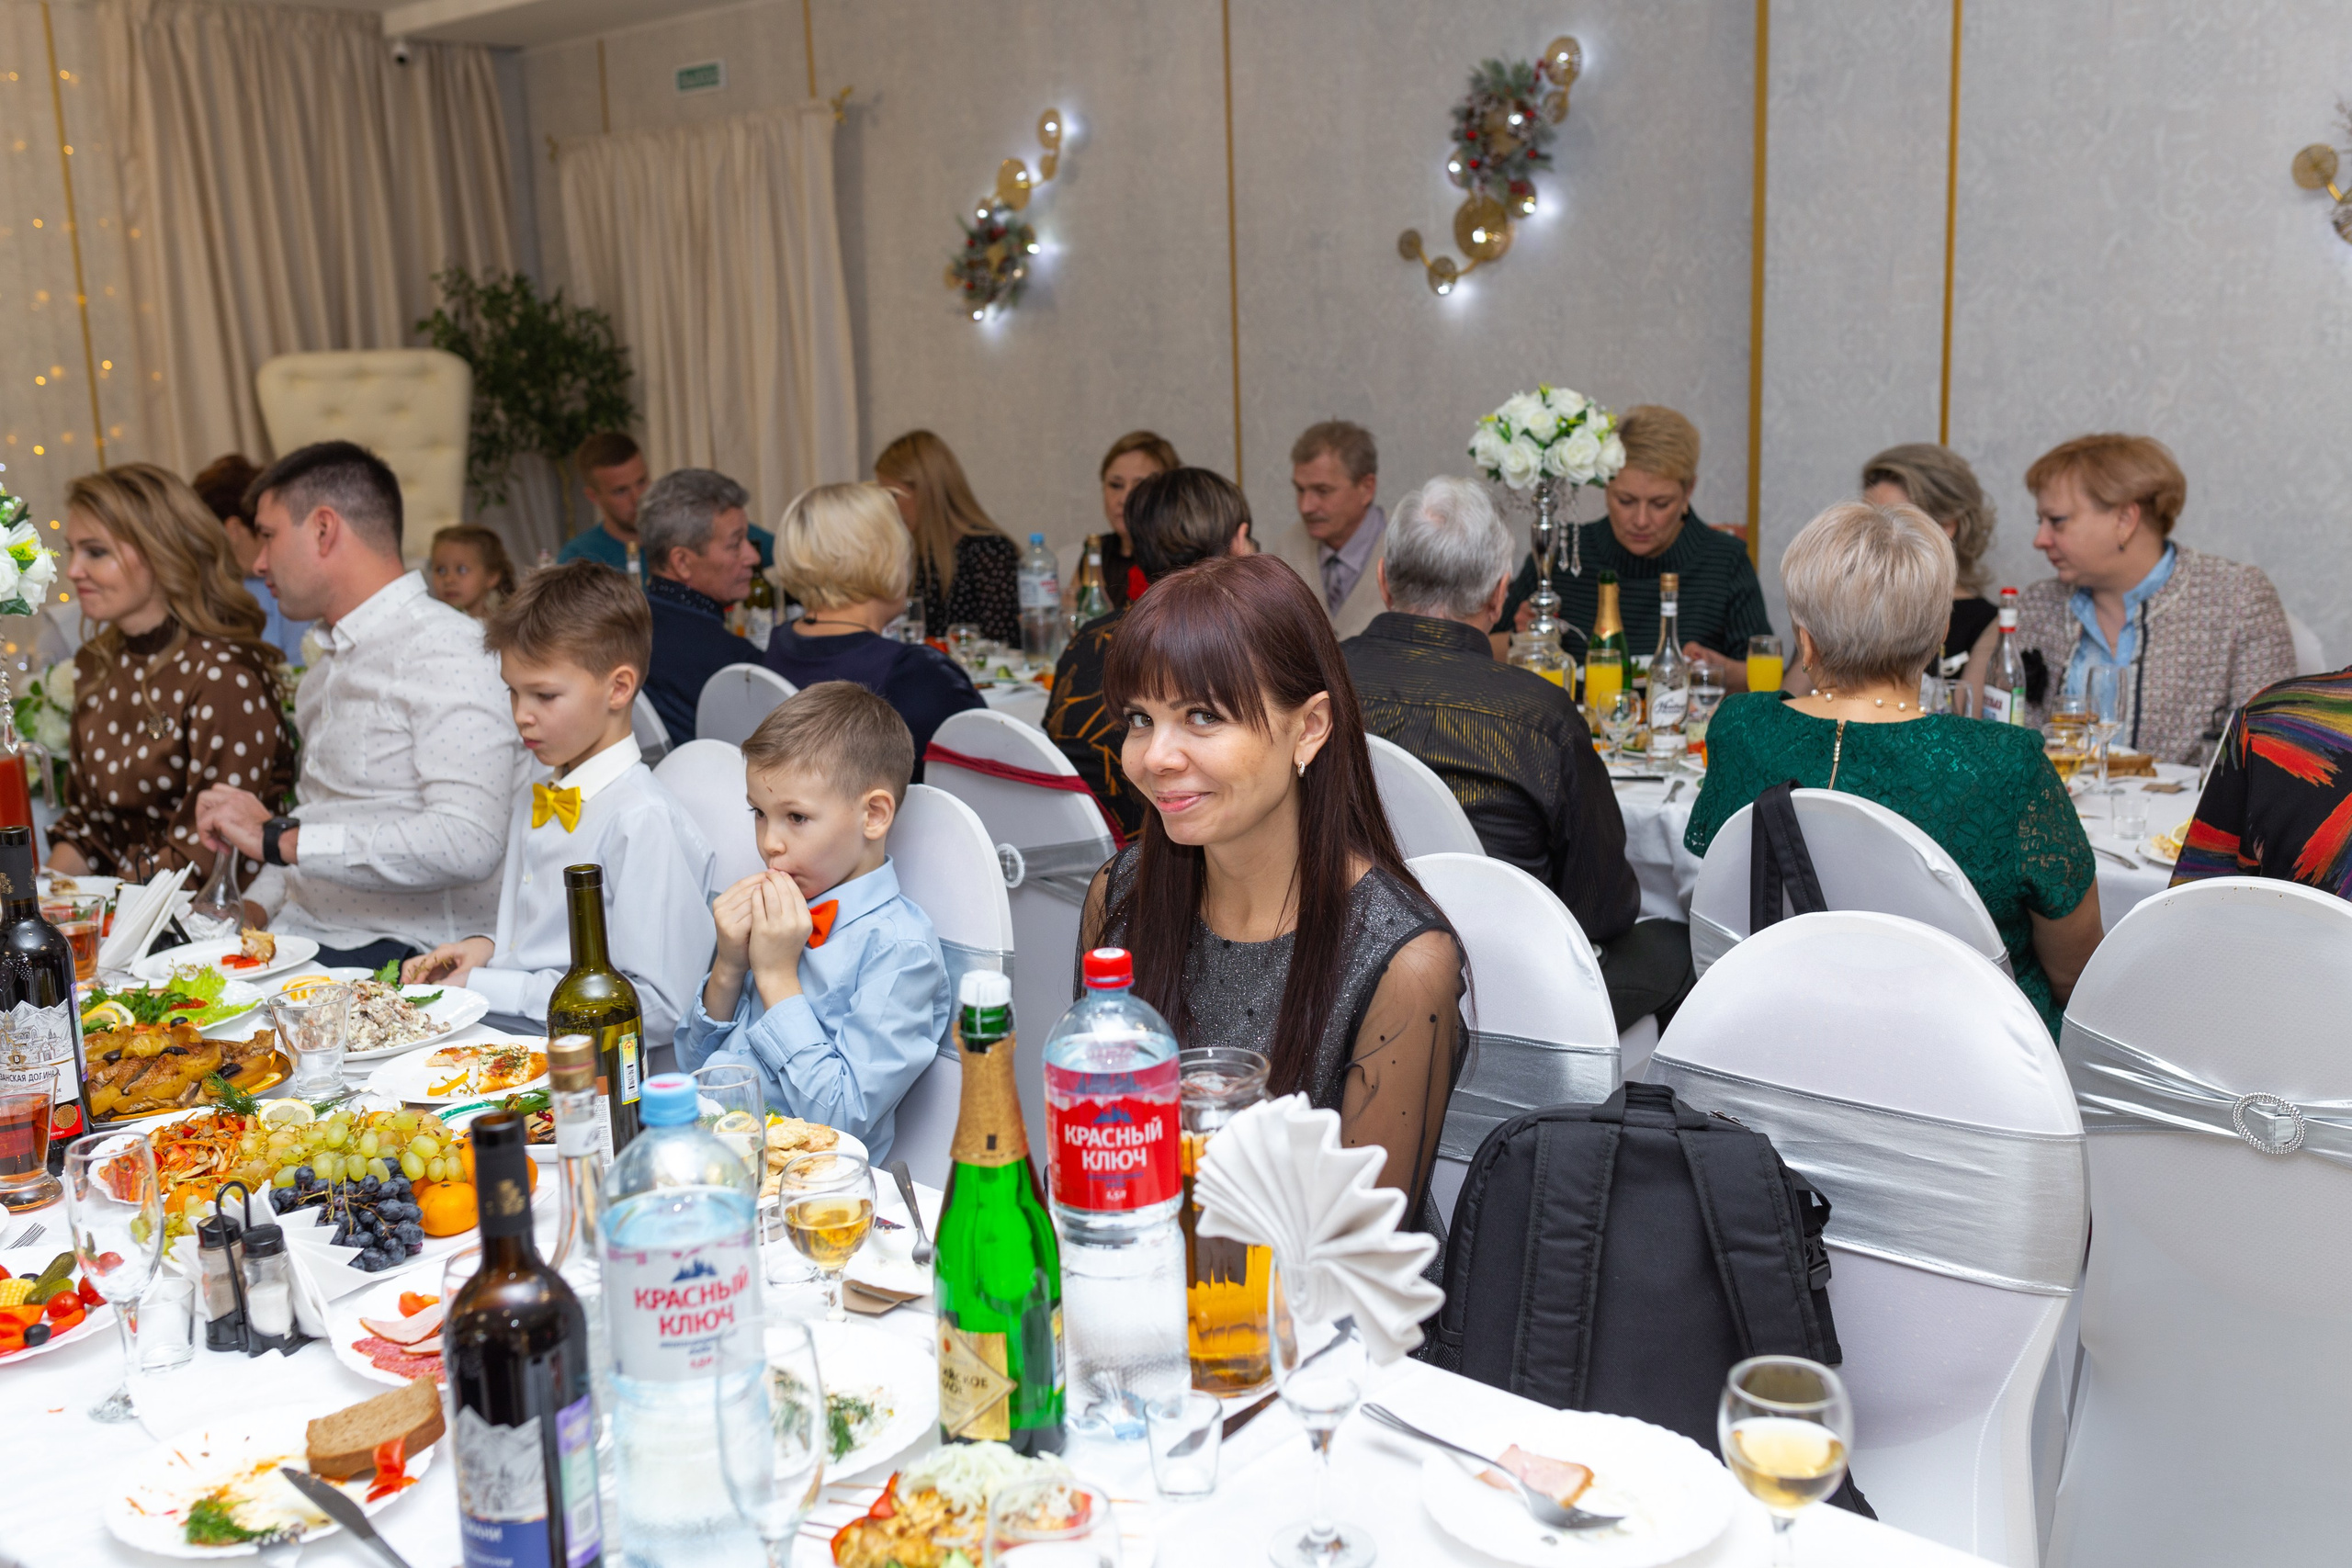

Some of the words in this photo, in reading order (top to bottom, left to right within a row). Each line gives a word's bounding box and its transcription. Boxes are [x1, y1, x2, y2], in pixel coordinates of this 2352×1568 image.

[1064, 1116, 1163, 1147] КРАСНЫЙ
[1081, 1147, 1148, 1171] КЛЮЧ
[634, 1264, 750, 1311] КРАСНЫЙ
[658, 1303, 735, 1337] КЛЮЧ
